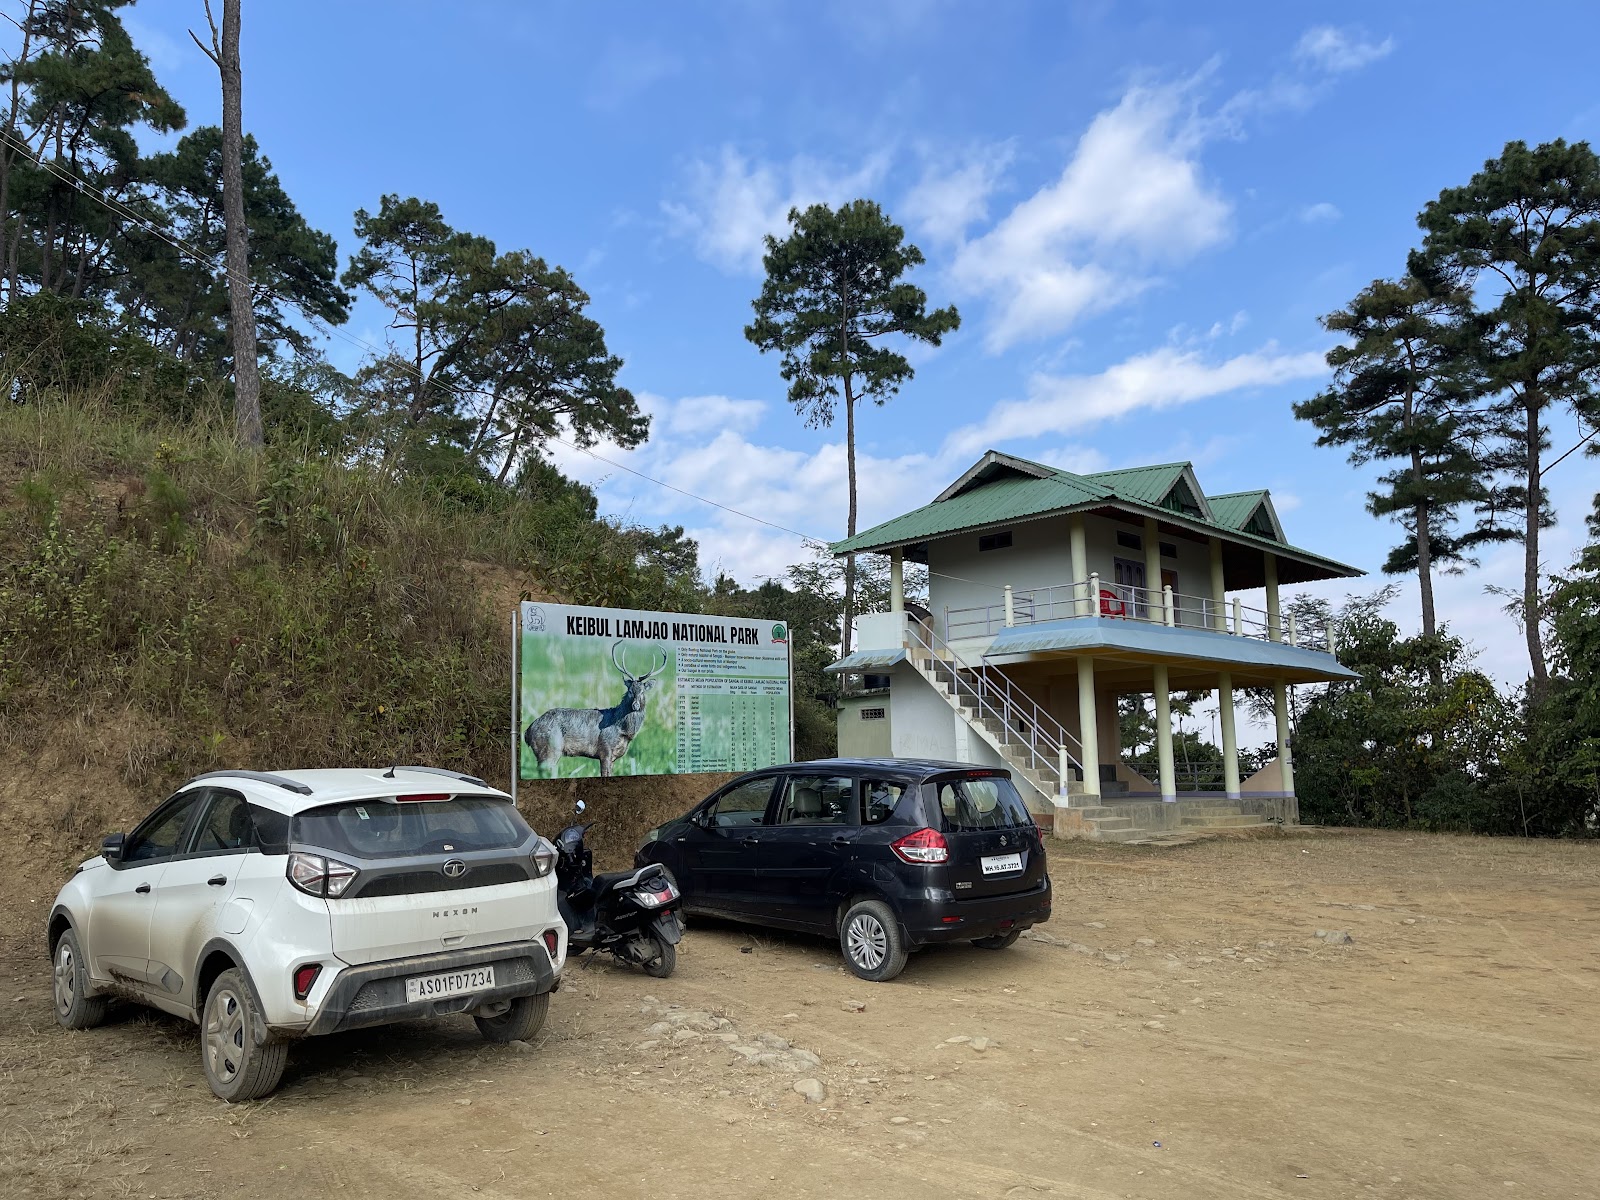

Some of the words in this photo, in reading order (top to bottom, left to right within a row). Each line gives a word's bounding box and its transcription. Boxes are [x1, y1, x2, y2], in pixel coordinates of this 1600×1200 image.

[566, 615, 612, 637] KEIBUL
[616, 619, 668, 640] LAMJAO
[672, 622, 727, 643] NATIONAL
[730, 626, 759, 645] PARK
[432, 907, 478, 918] NEXON
[419, 970, 492, 996] AS01FD7234
